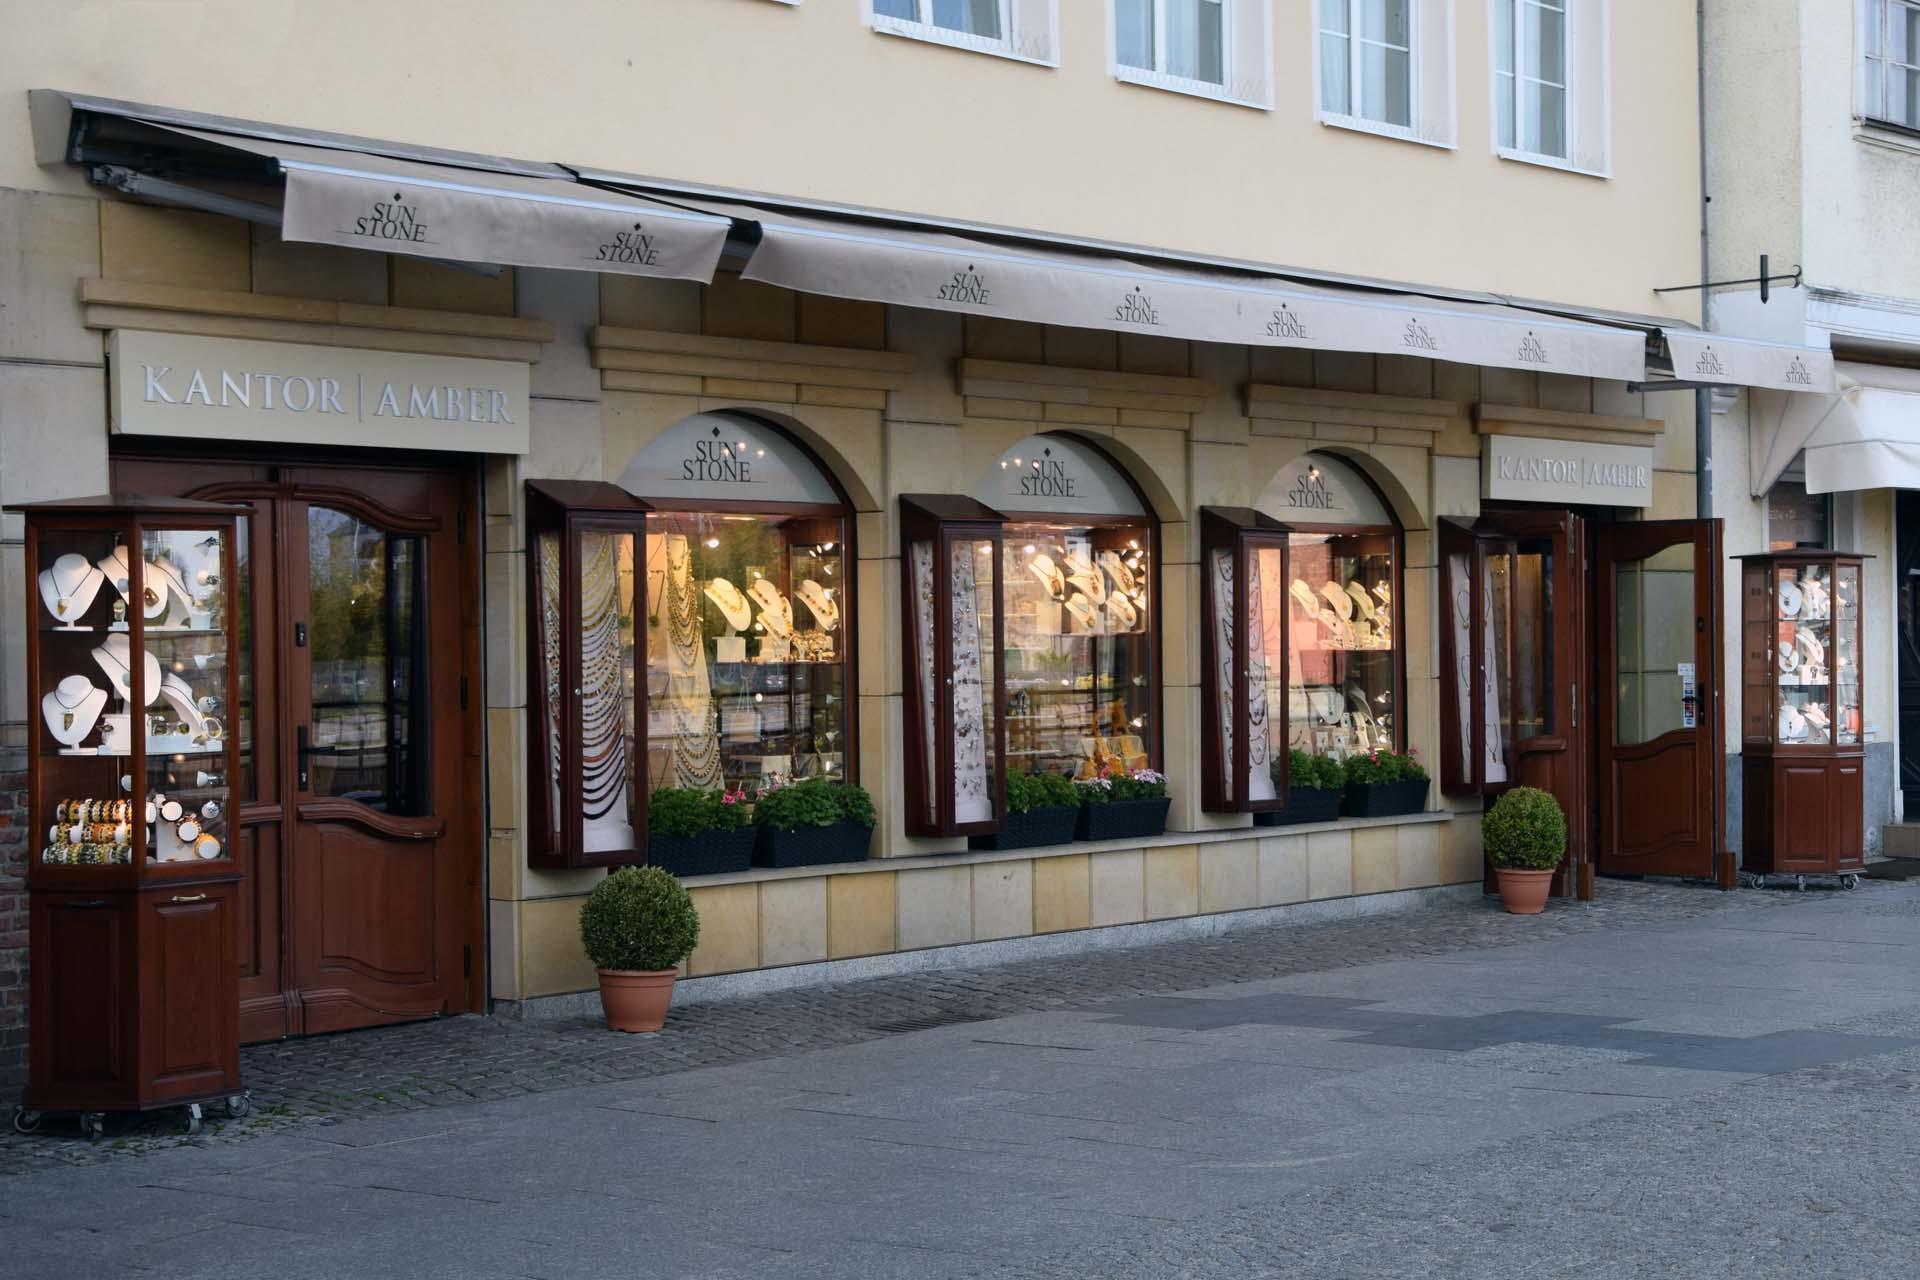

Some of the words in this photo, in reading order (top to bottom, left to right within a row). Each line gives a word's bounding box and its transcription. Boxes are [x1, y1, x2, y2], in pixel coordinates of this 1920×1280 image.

[373, 202, 416, 225] SUN
[354, 216, 427, 243] STONE
[615, 231, 655, 251] SUN
[596, 244, 660, 266] STONE
[952, 272, 984, 290] SUN
[937, 284, 991, 305] STONE
[1125, 294, 1151, 310] SUN
[1115, 306, 1159, 326] STONE
[1273, 311, 1298, 325] SUN
[1267, 322, 1306, 339] STONE
[1406, 323, 1429, 338] SUN
[1403, 334, 1438, 351] STONE
[1522, 337, 1542, 351] SUN
[1518, 348, 1547, 363] STONE
[1701, 352, 1718, 364] SUN
[1696, 362, 1724, 375] STONE
[1790, 362, 1807, 374] SUN
[1785, 372, 1812, 385] STONE
[142, 365, 347, 415] KANTOR
[373, 383, 515, 424] AMBER
[696, 440, 737, 462] SUN
[683, 459, 751, 482] STONE
[1031, 460, 1065, 478] SUN
[1498, 456, 1577, 484] KANTOR
[1586, 463, 1647, 488] AMBER
[1020, 476, 1075, 497] STONE
[1297, 475, 1325, 491] SUN
[1288, 490, 1334, 509] STONE
